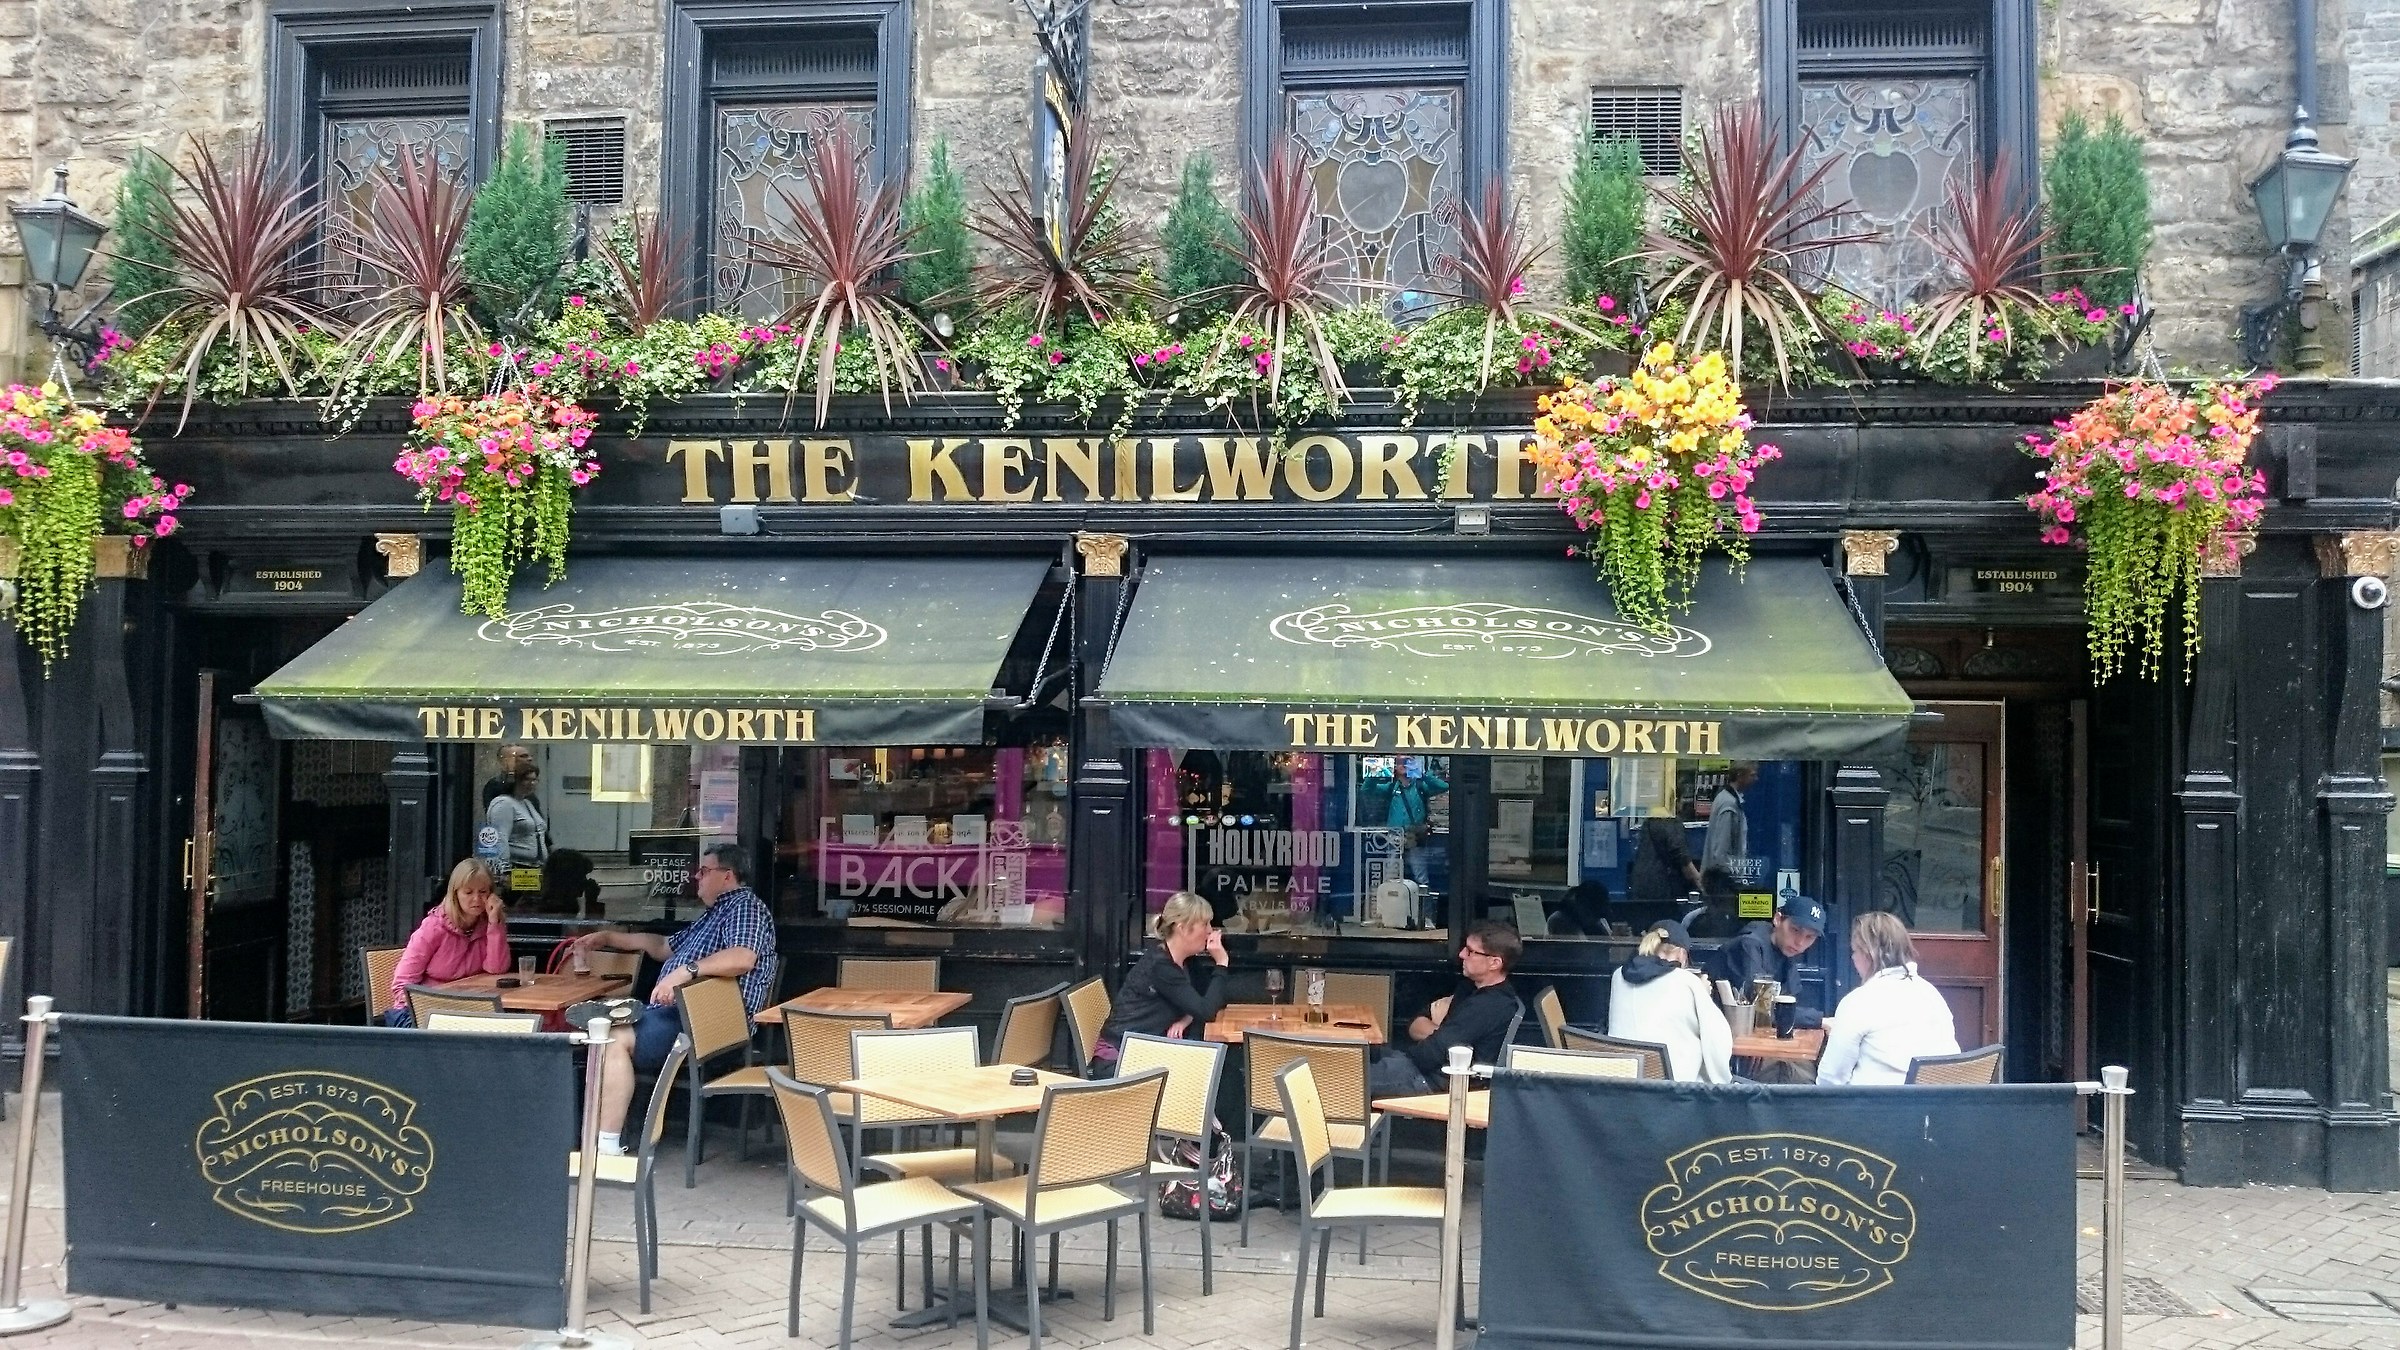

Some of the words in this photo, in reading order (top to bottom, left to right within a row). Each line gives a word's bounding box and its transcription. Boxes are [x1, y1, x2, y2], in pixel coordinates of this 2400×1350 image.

[666, 438, 859, 503] THE
[256, 570, 322, 579] ESTABLISHED
[1977, 570, 2058, 580] ESTABLISHED
[274, 580, 303, 591] 1904
[1999, 581, 2034, 593] 1904
[541, 613, 827, 637] NICHOLSON'S
[1336, 615, 1646, 642] NICHOLSON'S
[1442, 643, 1477, 652] EST.
[416, 707, 505, 739] THE
[519, 707, 816, 742] KENILWORTH
[1283, 712, 1379, 749] THE
[1394, 712, 1721, 755] KENILWORTH
[1209, 829, 1340, 867] HOLLYROOD
[650, 858, 686, 867] PLEASE
[1729, 859, 1762, 867] FREE
[1729, 867, 1761, 875] WIFI
[643, 870, 690, 883] ORDER
[839, 855, 968, 900] BACK
[1217, 874, 1279, 893] PALE
[1285, 877, 1331, 894] ALE
[651, 883, 683, 896] food
[872, 904, 912, 915] SESSION
[914, 905, 935, 915] PALE
[270, 1083, 308, 1100] EST.
[316, 1084, 358, 1103] 1873
[220, 1126, 409, 1176] NICHOLSON'S
[1728, 1147, 1773, 1164] EST.
[1782, 1147, 1831, 1167] 1873
[261, 1180, 366, 1197] FREEHOUSE
[1667, 1195, 1888, 1245] NICHOLSON'S
[1716, 1252, 1840, 1269] FREEHOUSE
